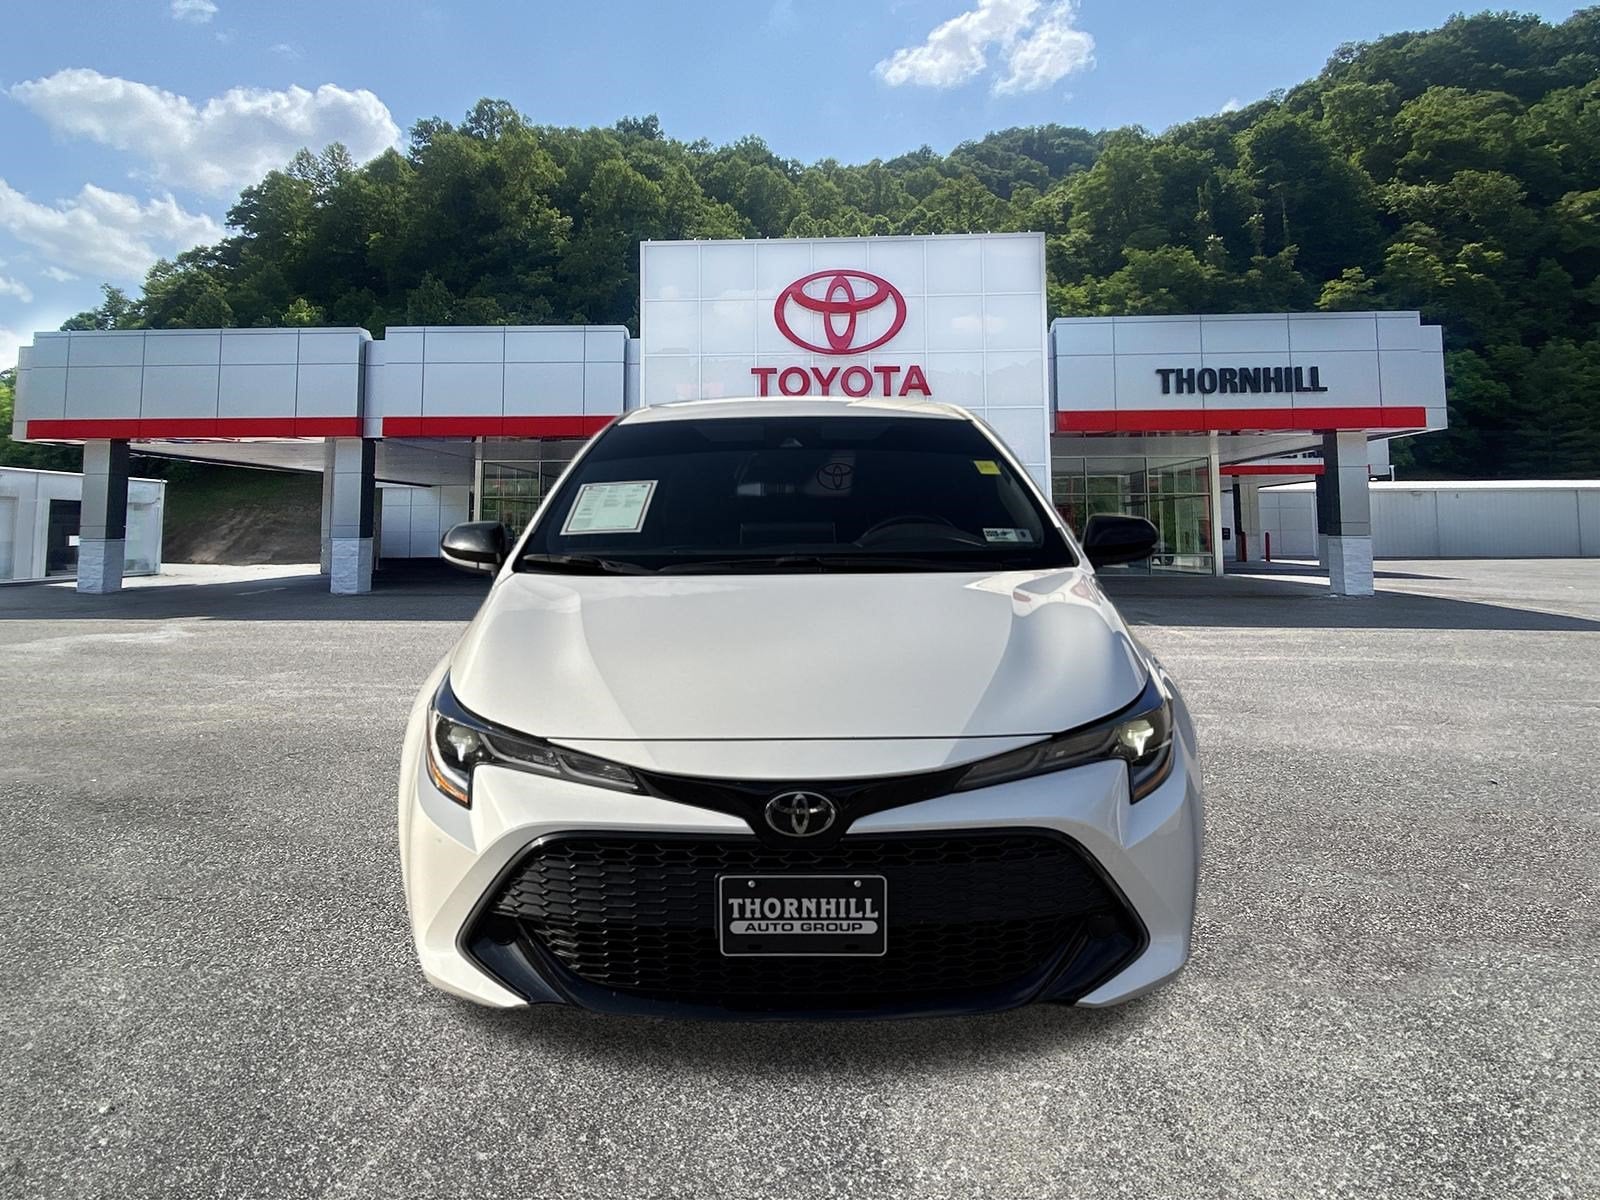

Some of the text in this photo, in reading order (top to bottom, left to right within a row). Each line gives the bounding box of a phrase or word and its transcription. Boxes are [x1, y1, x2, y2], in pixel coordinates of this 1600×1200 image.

[751, 365, 932, 397] TOYOTA
[1155, 366, 1328, 395] THORNHILL
[728, 897, 879, 919] THORNHILL
[745, 922, 863, 932] AUTO GROUP
